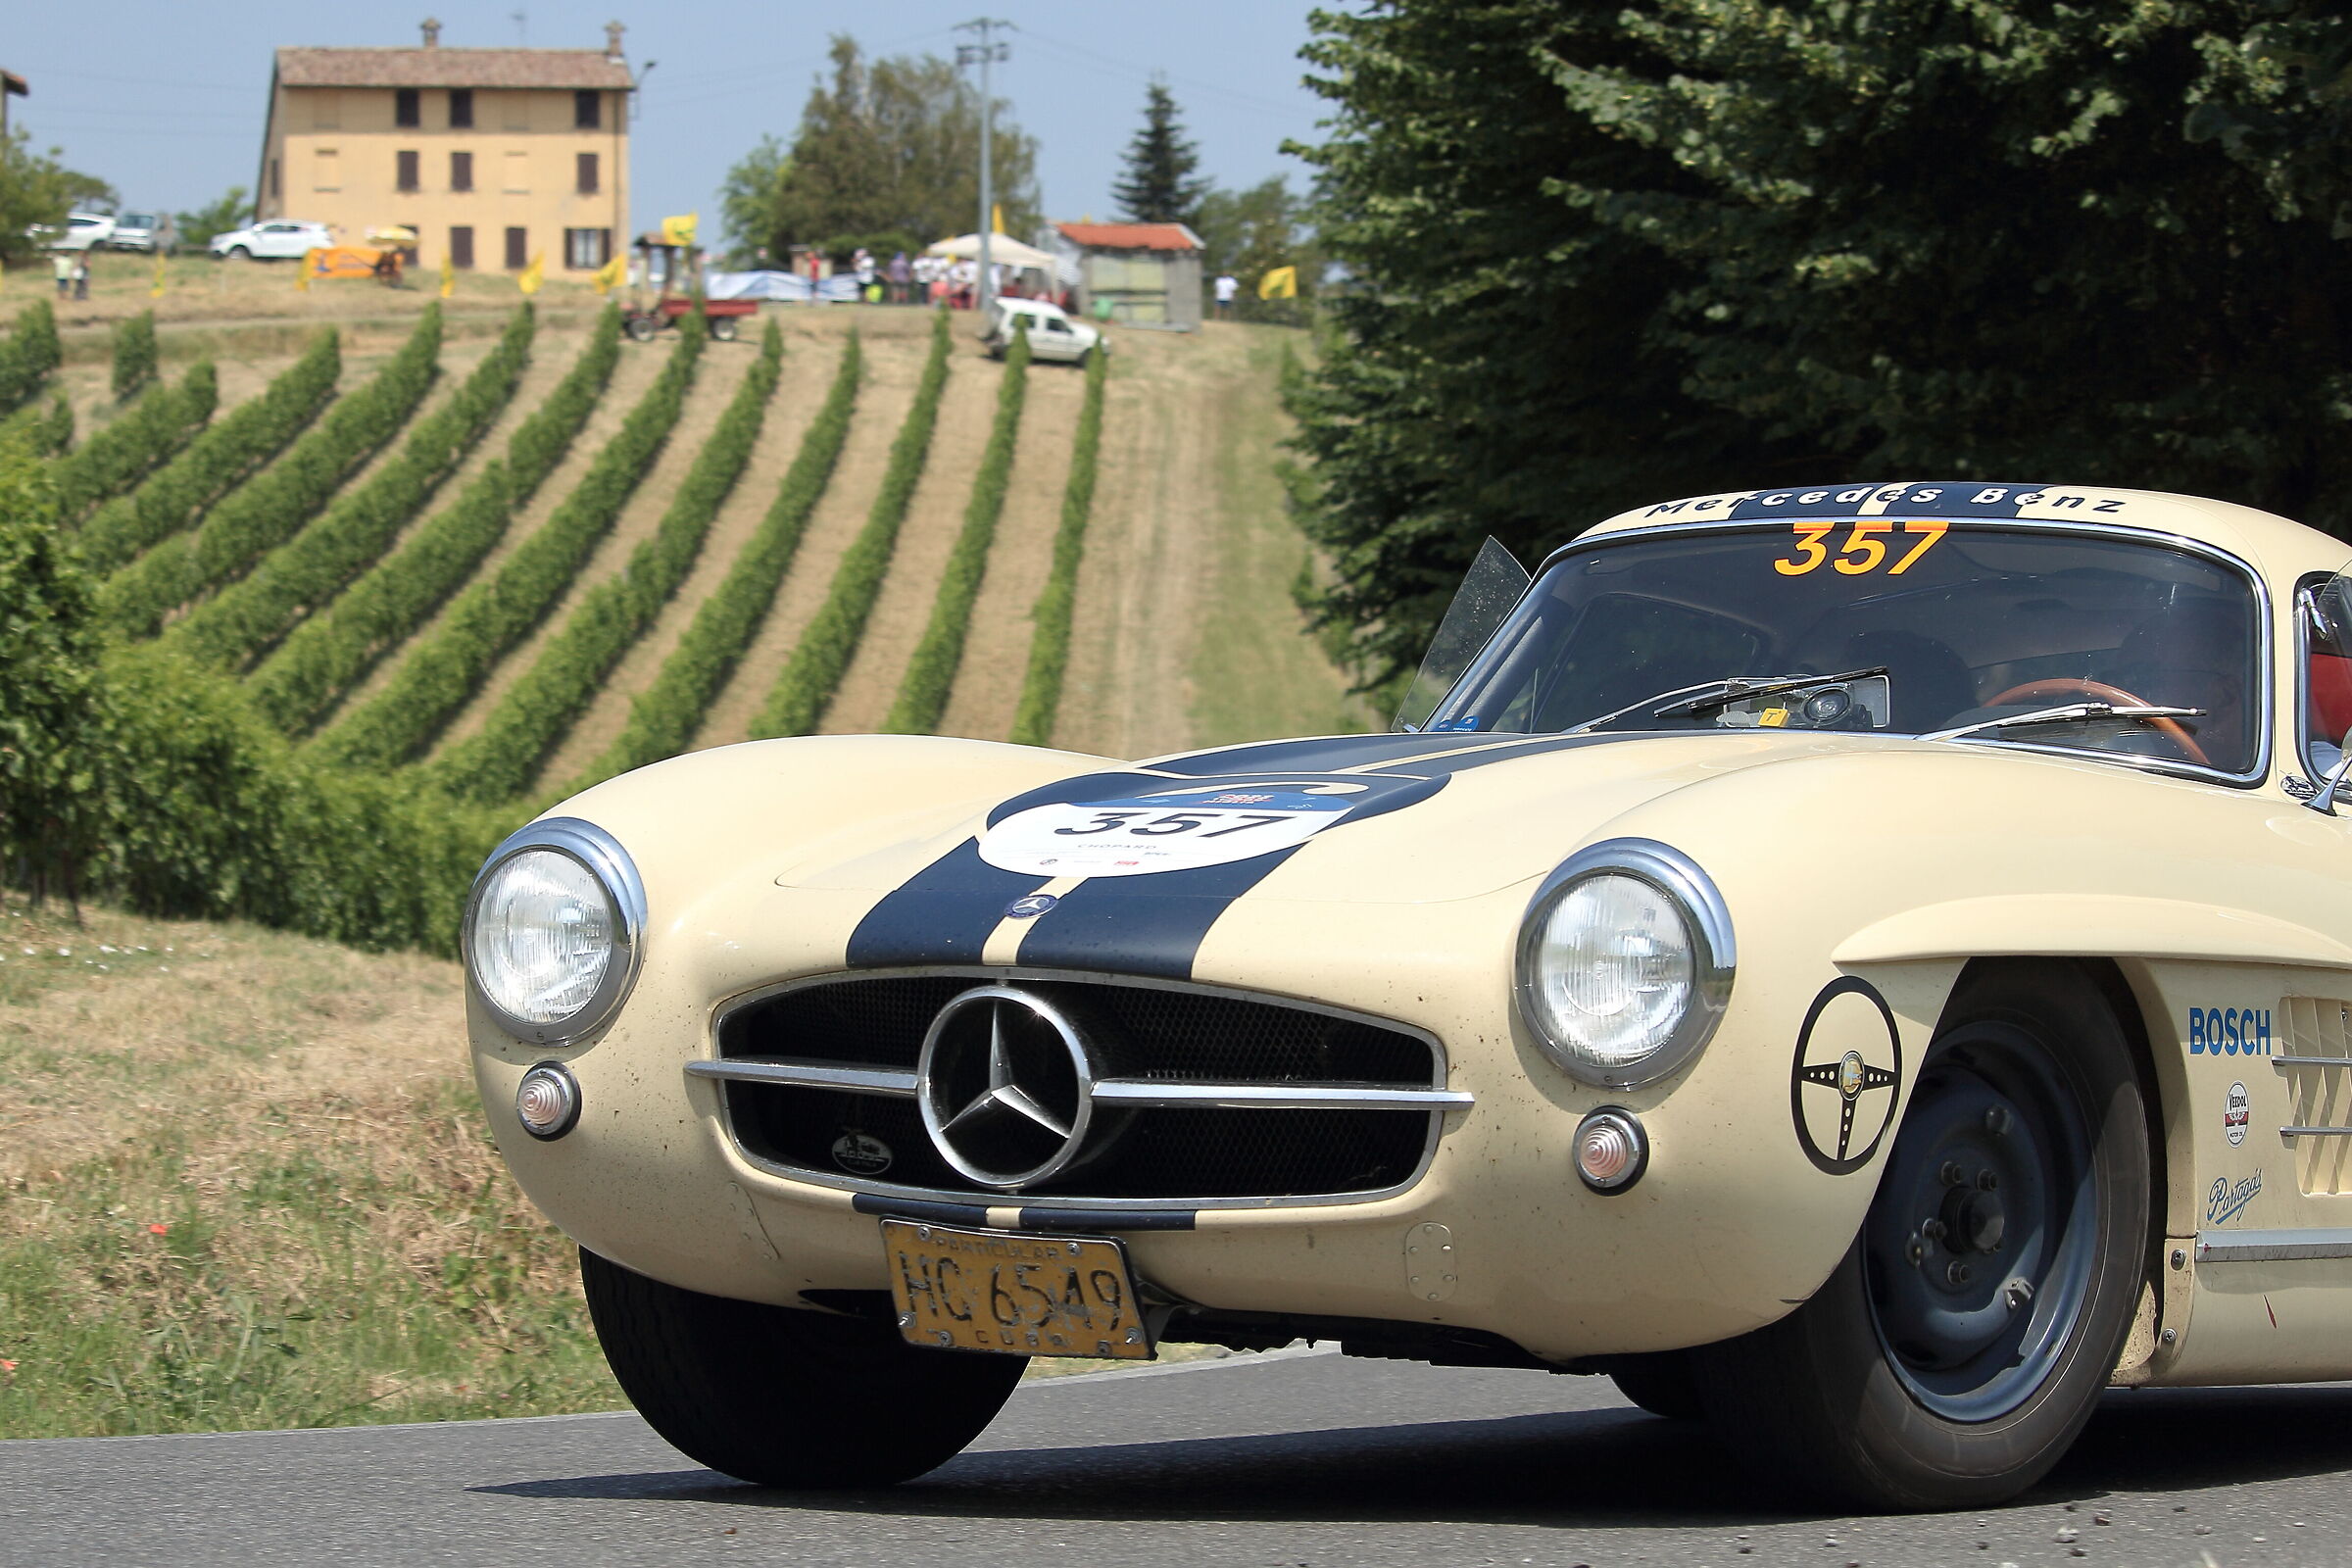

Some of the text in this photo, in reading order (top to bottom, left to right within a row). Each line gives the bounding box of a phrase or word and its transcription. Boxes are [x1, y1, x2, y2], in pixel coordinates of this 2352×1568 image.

[1644, 485, 2126, 518] Mercedes Benz
[1773, 520, 1950, 575] 357
[1054, 812, 1298, 838] 357
[2188, 1006, 2272, 1056] BOSCH
[2229, 1094, 2246, 1111] VEEDOL
